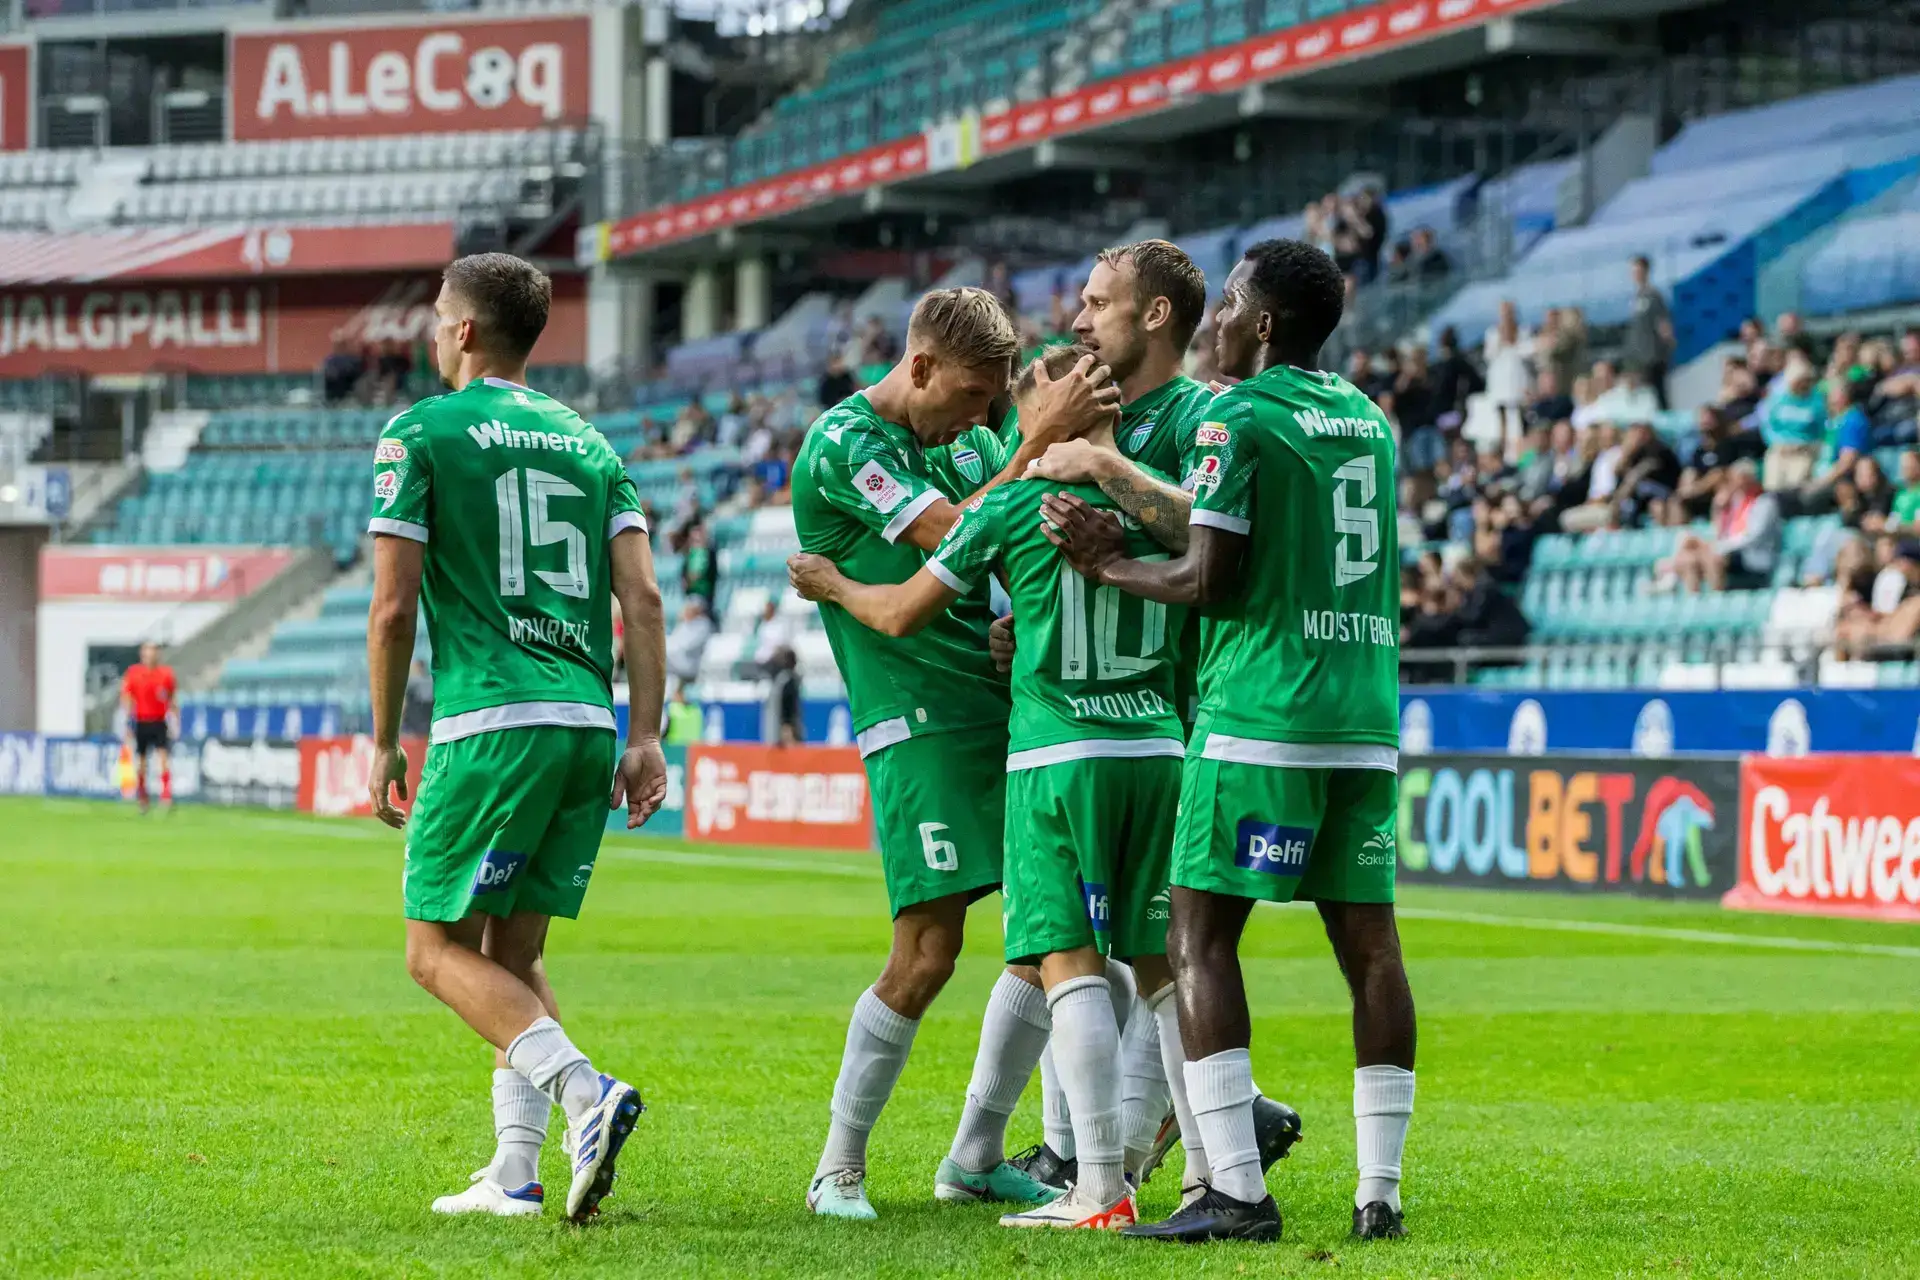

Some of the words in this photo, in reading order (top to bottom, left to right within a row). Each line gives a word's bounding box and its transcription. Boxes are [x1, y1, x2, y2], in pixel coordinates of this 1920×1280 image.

[467, 419, 588, 456] Winnerz
[1292, 406, 1385, 439] Winnerz
[495, 467, 589, 599] 15
[1061, 552, 1170, 680] 10
[919, 822, 958, 871] 6
[1398, 766, 1635, 884] COOLBET
[1249, 834, 1305, 865] Delfi
[1357, 852, 1384, 866] Saku
